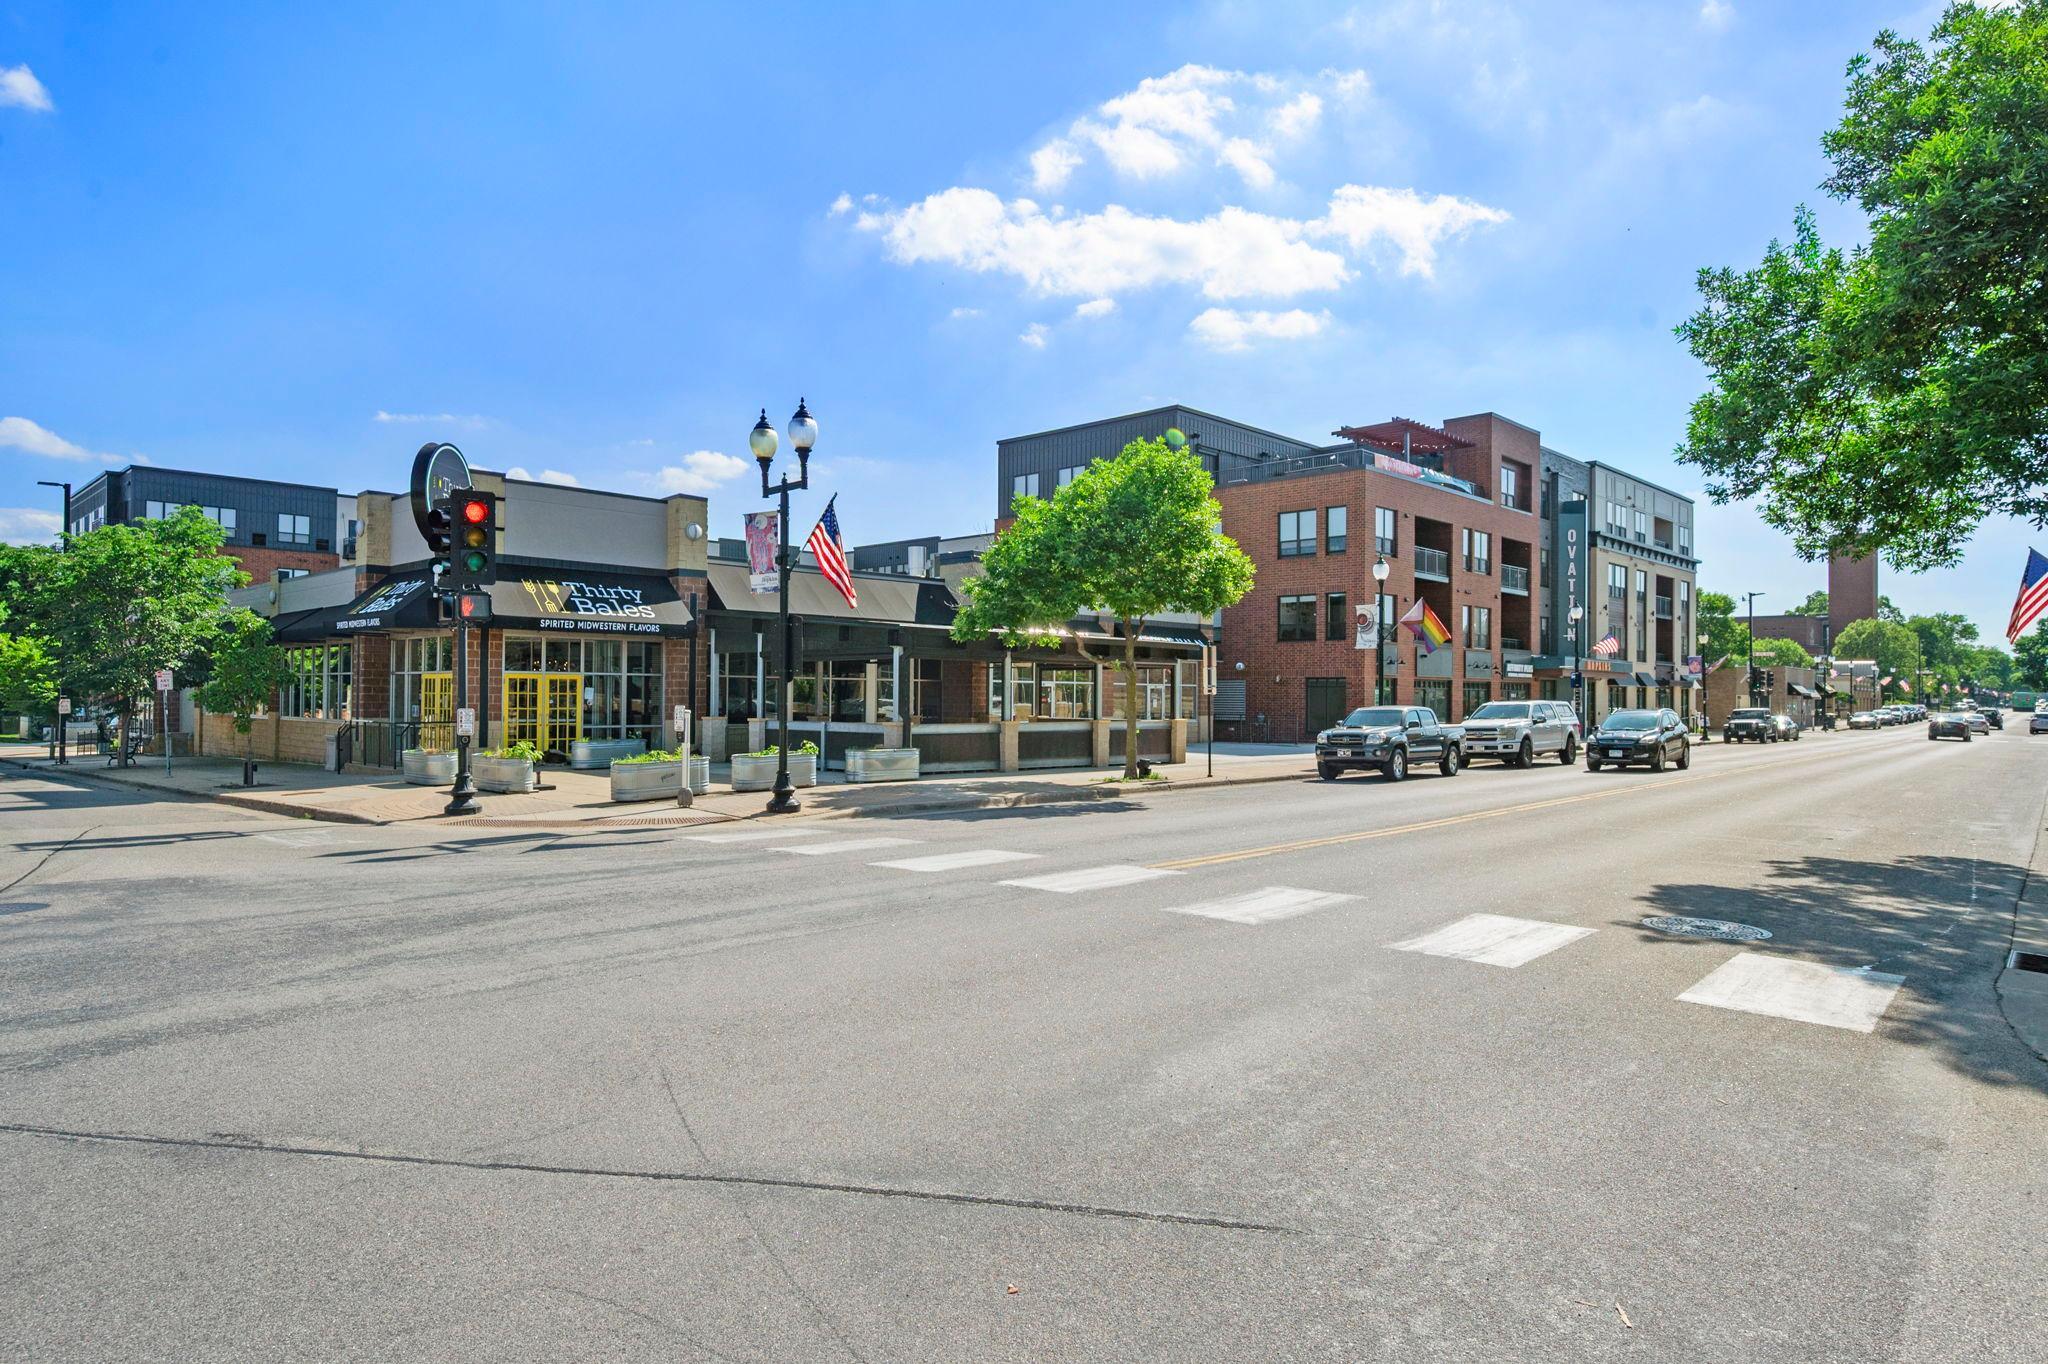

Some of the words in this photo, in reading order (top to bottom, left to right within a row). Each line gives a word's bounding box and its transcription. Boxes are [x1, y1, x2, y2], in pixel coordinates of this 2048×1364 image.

[561, 581, 643, 604] Thirty
[571, 597, 656, 618] Bales
[540, 619, 575, 629] SPIRITED
[577, 621, 627, 631] MIDWESTERN
[629, 623, 661, 633] FLAVORS
